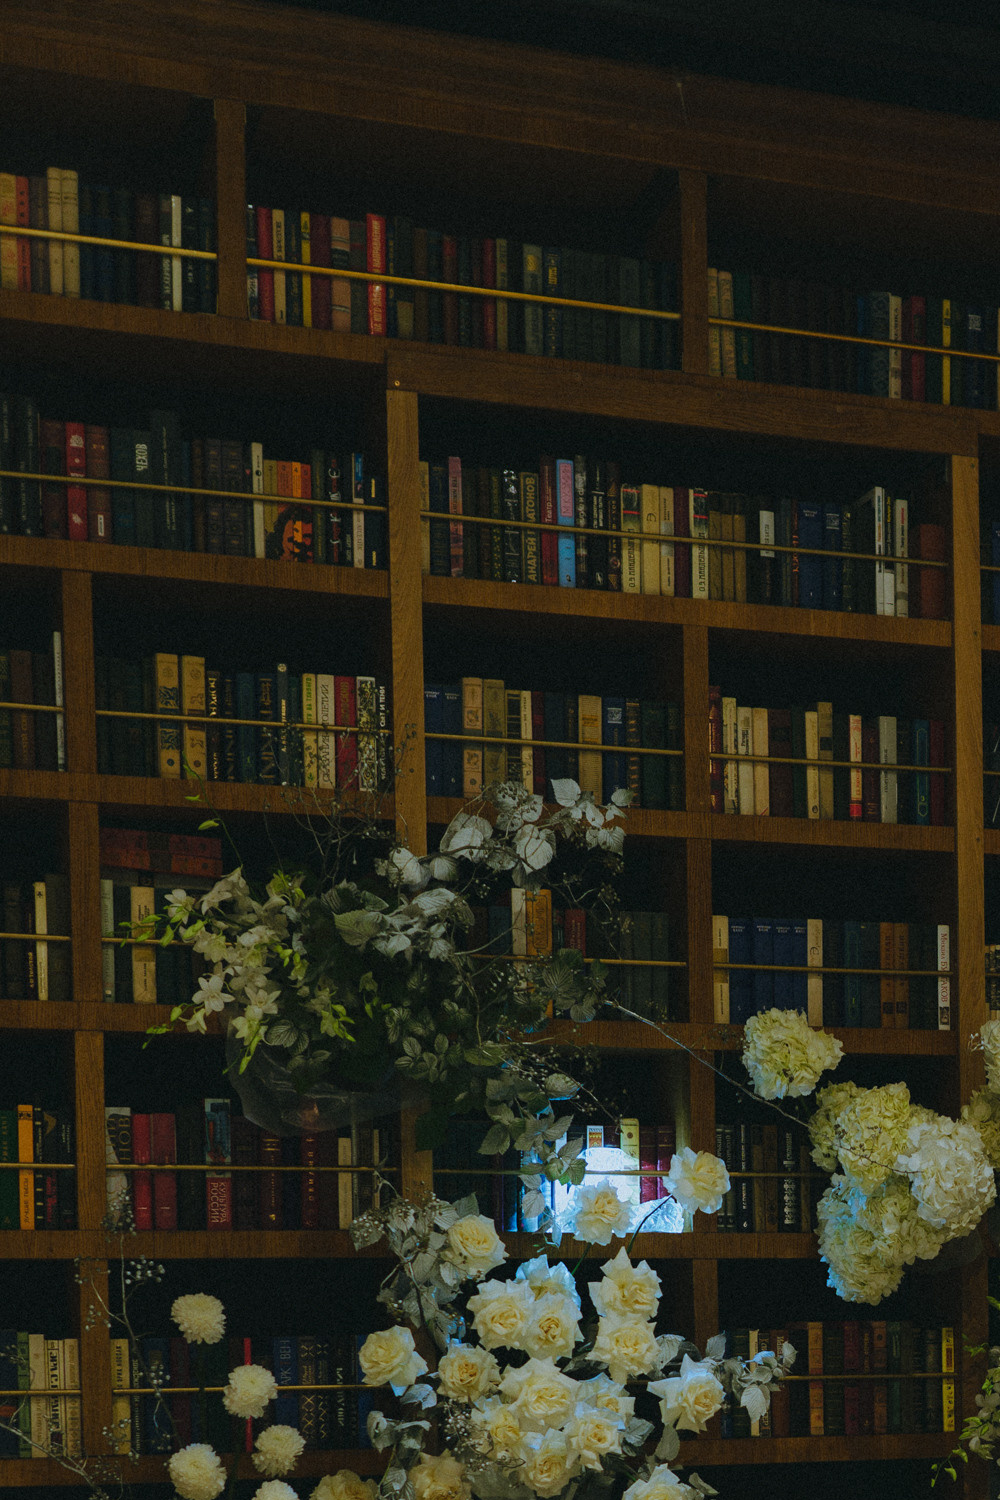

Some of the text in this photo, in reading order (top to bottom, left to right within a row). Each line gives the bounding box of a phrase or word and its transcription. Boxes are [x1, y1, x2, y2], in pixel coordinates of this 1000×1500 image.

[136, 444, 148, 470] ЧЕХОВ
[526, 477, 537, 582] АНДРЕЙ ПАТОНОВ
[210, 1182, 219, 1223] РОССИИ
[219, 1182, 227, 1223] КУЛЬТУРА
